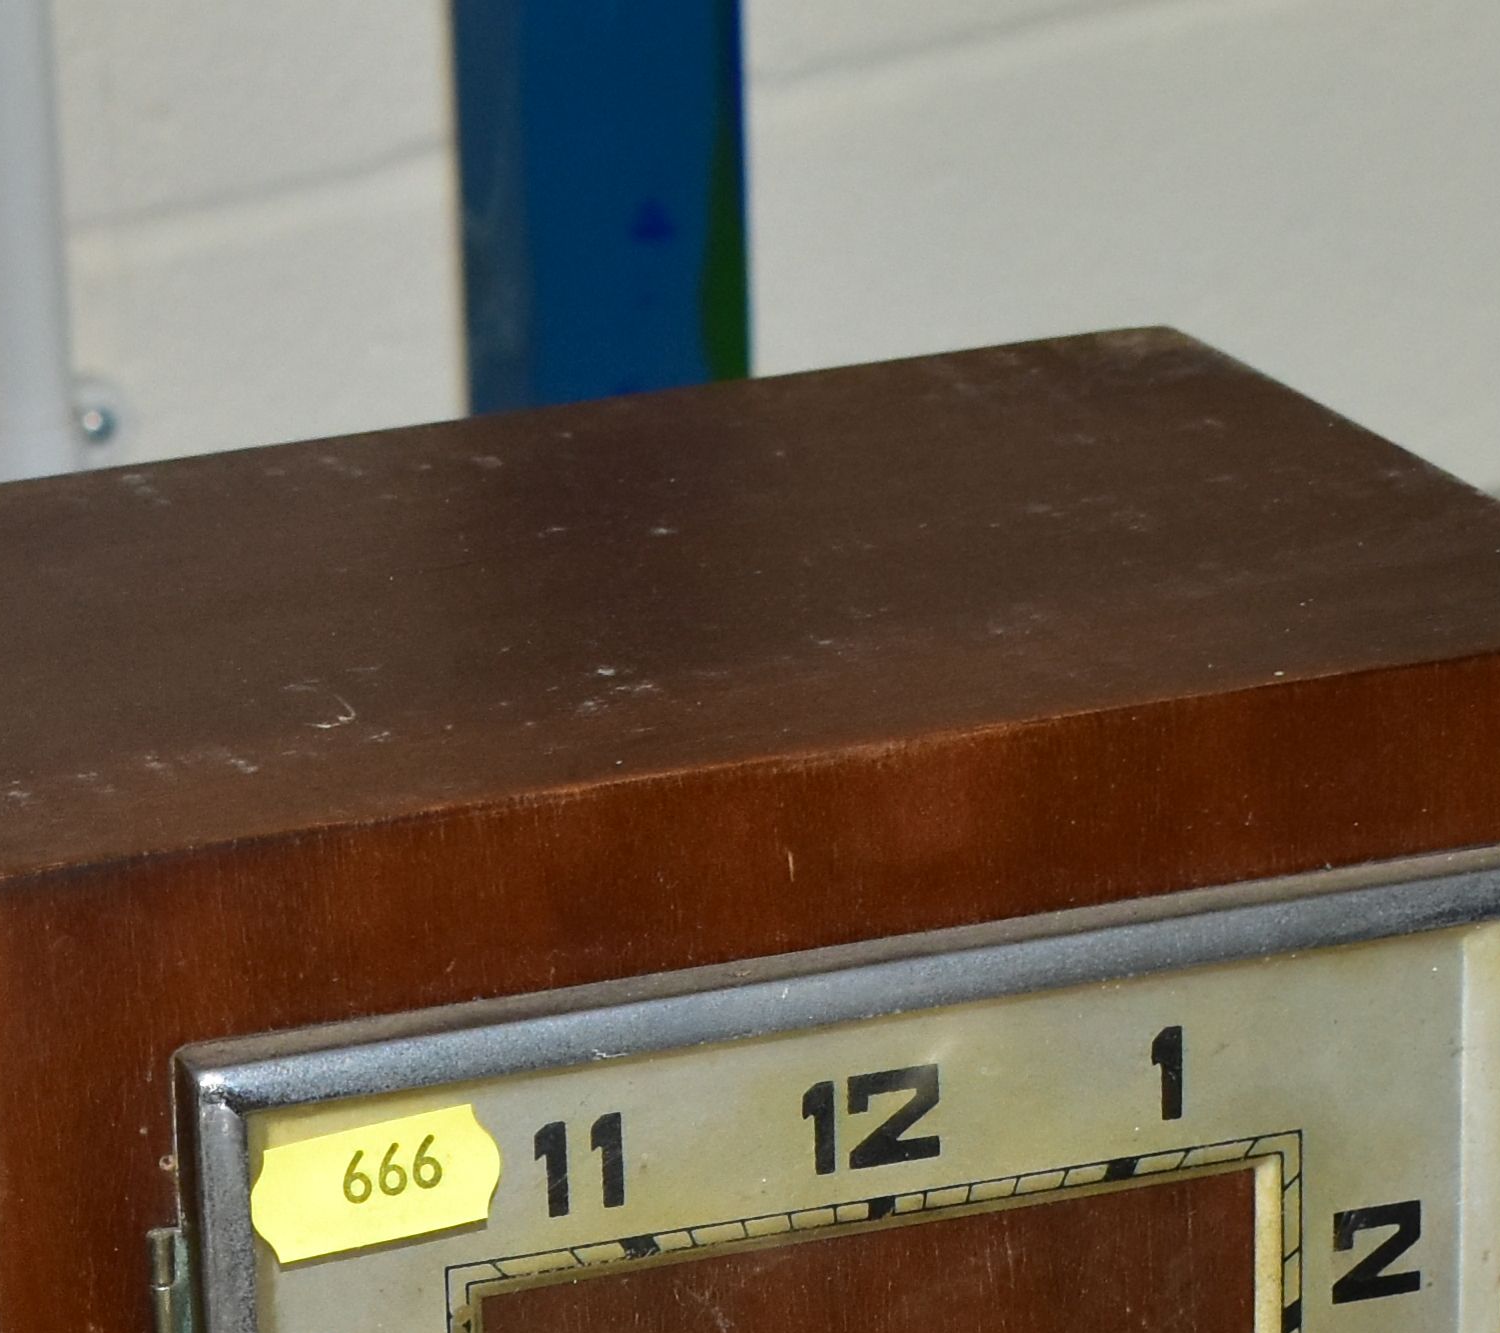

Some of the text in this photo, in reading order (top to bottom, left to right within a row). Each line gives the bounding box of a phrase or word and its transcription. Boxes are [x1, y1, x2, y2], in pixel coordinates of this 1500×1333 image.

[802, 1063, 941, 1176] 12
[1149, 1024, 1184, 1121] 1
[340, 1133, 446, 1206] 666
[533, 1112, 625, 1218] 11
[1331, 1200, 1422, 1306] 2
